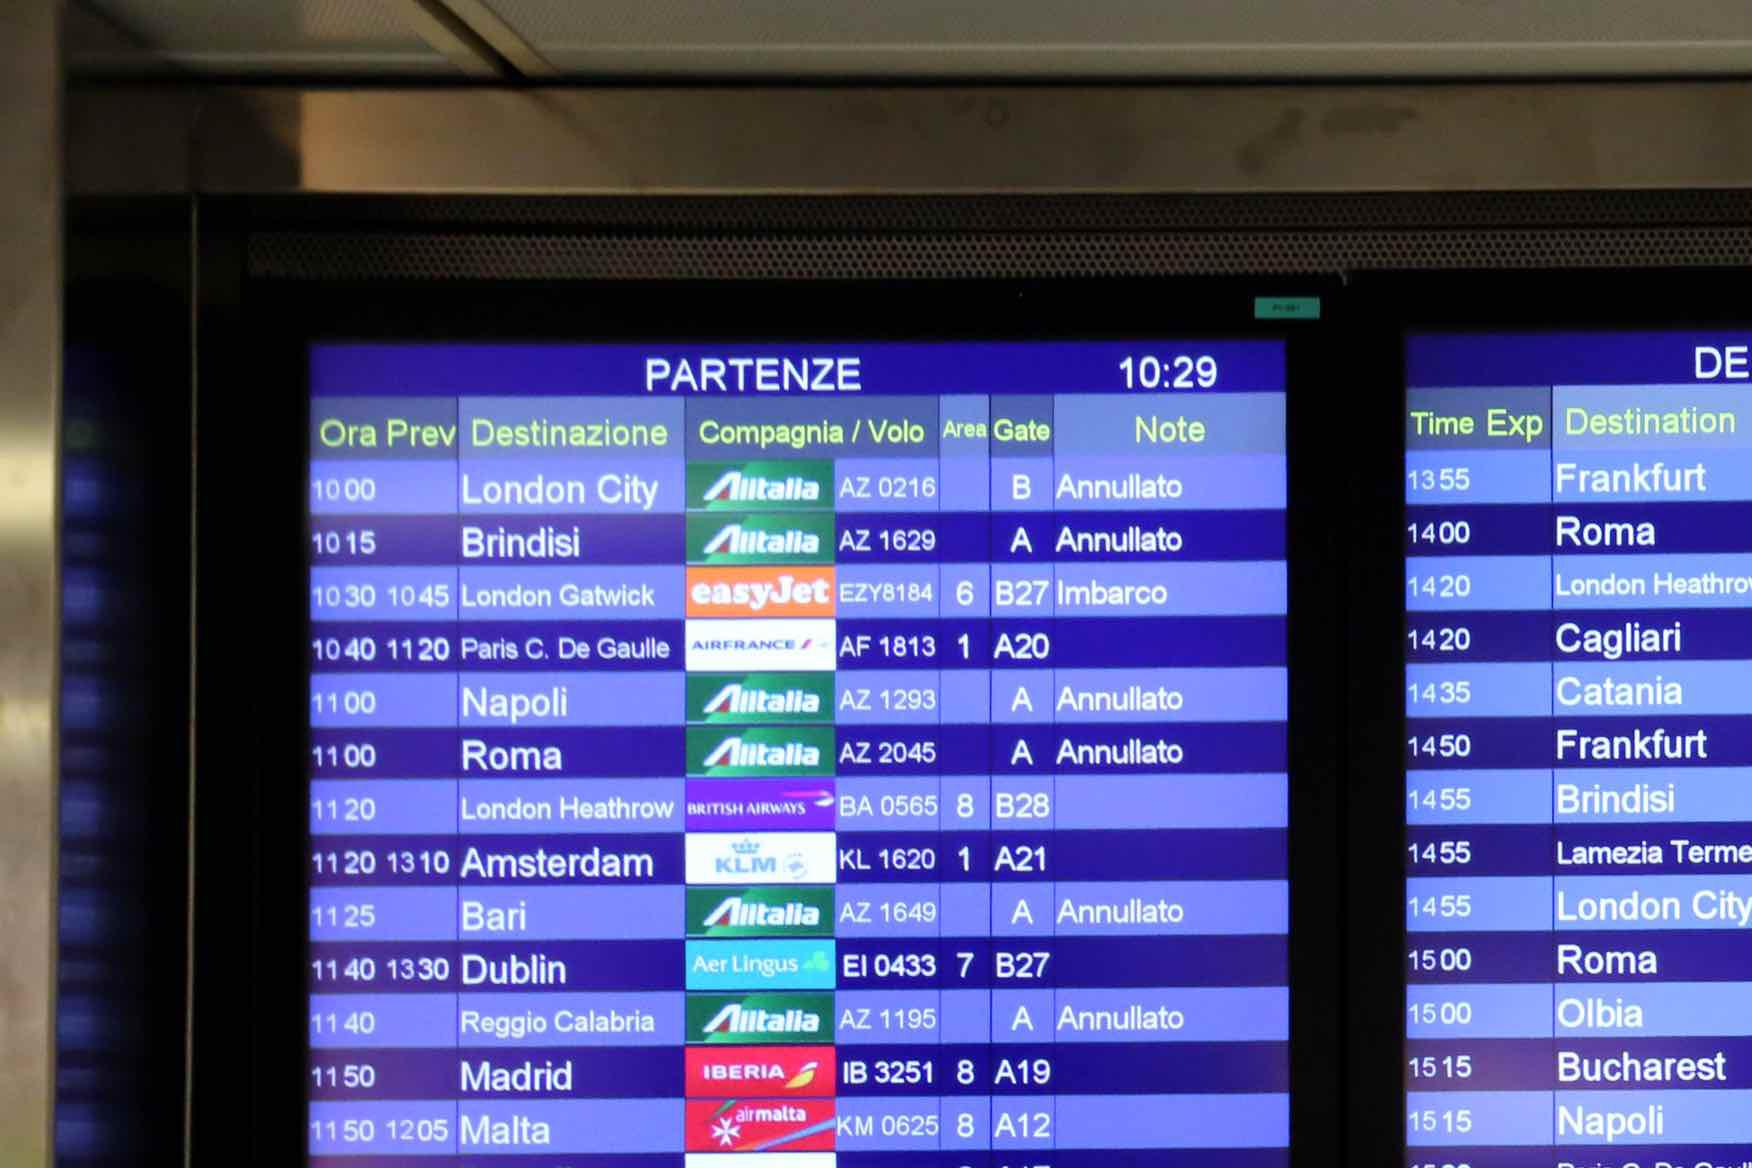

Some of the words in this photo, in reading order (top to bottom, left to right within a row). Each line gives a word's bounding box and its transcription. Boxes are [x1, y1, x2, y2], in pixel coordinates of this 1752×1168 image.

[646, 357, 862, 392] PARTENZE
[1119, 355, 1218, 390] 10:29
[320, 419, 377, 447] Ora
[387, 419, 457, 447] Prev
[472, 418, 668, 447] Destinazione
[699, 419, 844, 449] Compagnia
[851, 419, 861, 444] /
[867, 419, 925, 444] Volo
[942, 420, 987, 438] Area
[993, 418, 1051, 442] Gate
[1135, 415, 1206, 444] Note
[1410, 411, 1475, 435] Time
[1487, 408, 1543, 443] Exp
[1566, 406, 1736, 435] Destination
[462, 474, 585, 505] London
[597, 473, 659, 511] City
[839, 476, 872, 499] AZ
[878, 476, 936, 498] 0216
[1055, 473, 1183, 500] Annullato
[1556, 462, 1707, 493] Frankfurt
[462, 526, 580, 558] Brindisi
[1556, 515, 1656, 547] Roma
[461, 583, 552, 607] London
[559, 583, 655, 607] Gatwick
[691, 575, 830, 611] easyJet
[839, 582, 933, 603] EZY8184
[995, 580, 1050, 606] B27
[1057, 579, 1168, 606] Imbarco
[461, 637, 519, 660] Paris
[524, 637, 549, 660] C.
[558, 636, 591, 660] De
[596, 636, 671, 660] Gaulle
[993, 632, 1050, 660] A20
[462, 686, 568, 724] Napoli
[687, 802, 743, 817] BRITISH
[746, 801, 806, 816] AIRWAYS
[460, 846, 654, 878] Amsterdam
[715, 857, 777, 873] KLM
[1557, 840, 1664, 865] Lamezia
[462, 953, 567, 985] Dublin
[693, 955, 729, 972] Aer
[732, 954, 800, 979] Lingus
[843, 954, 867, 978] EI
[874, 953, 937, 977] 0433
[461, 1010, 547, 1039] Reggio
[554, 1009, 655, 1033] Calabria
[1558, 997, 1644, 1028] Olbia
[460, 1060, 573, 1092] Madrid
[703, 1064, 786, 1080] IBERIA
[1558, 1051, 1727, 1082] Bucharest
[460, 1114, 550, 1145] Malta
[993, 1112, 1051, 1138] A12
